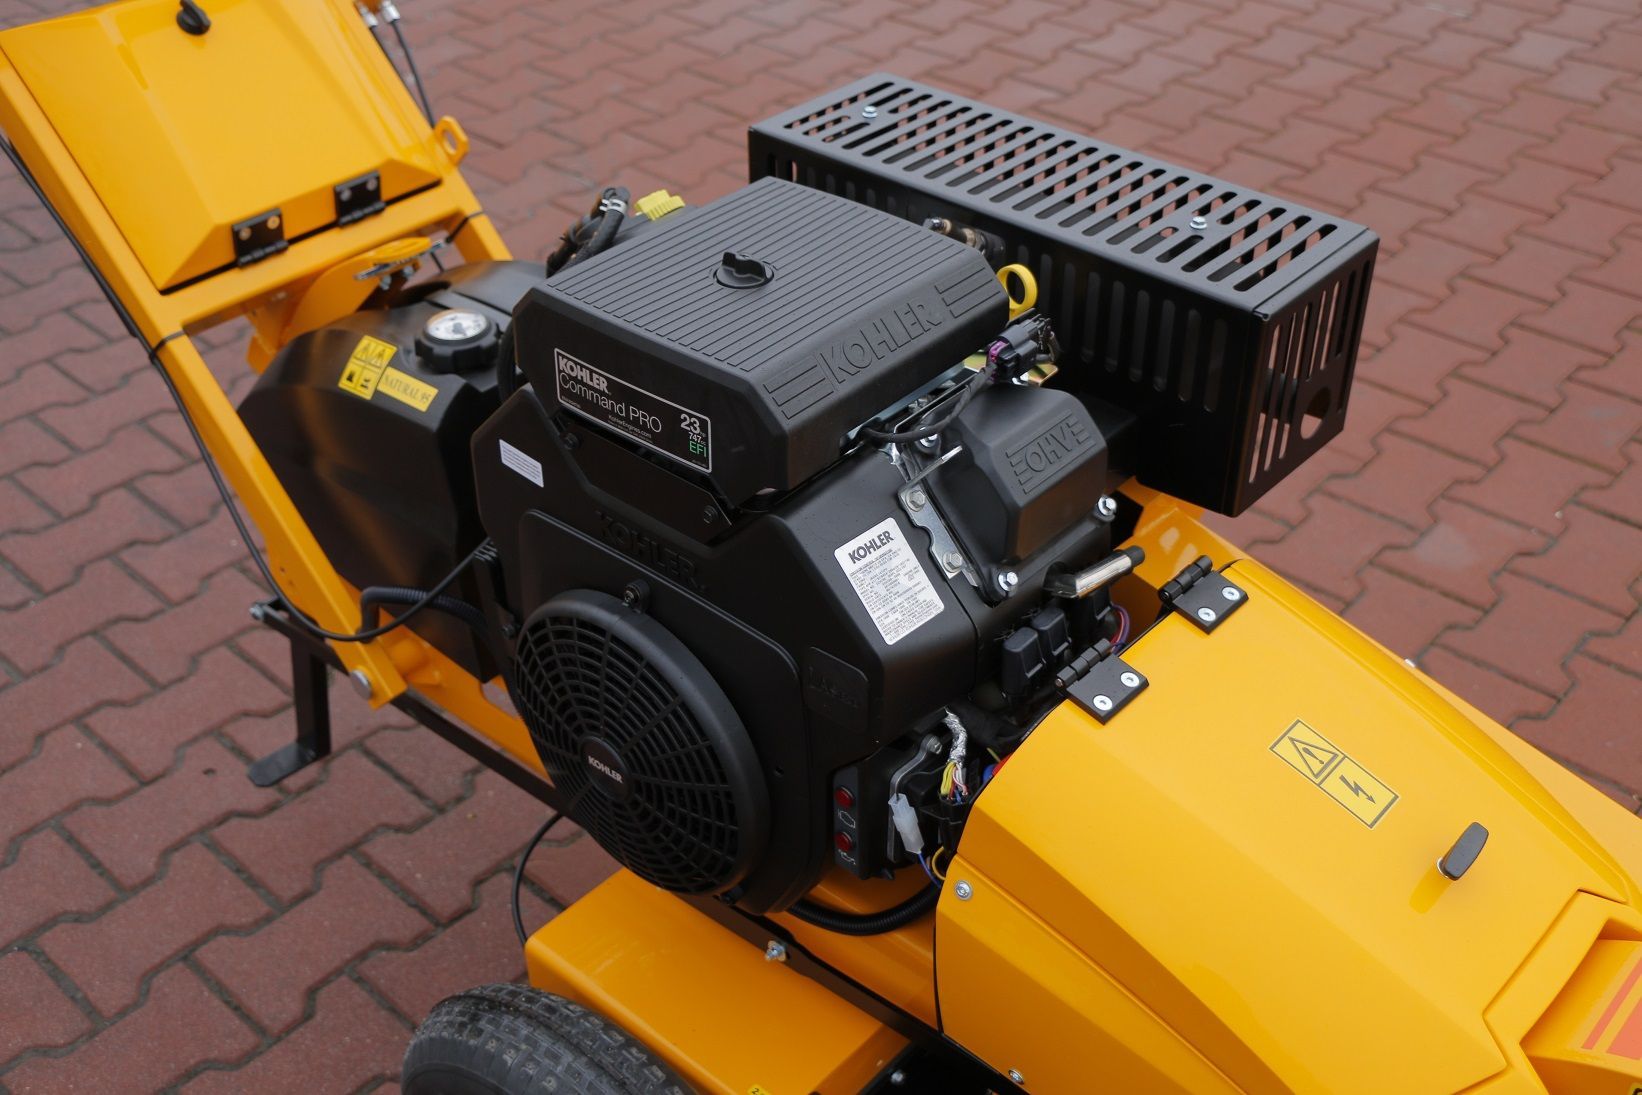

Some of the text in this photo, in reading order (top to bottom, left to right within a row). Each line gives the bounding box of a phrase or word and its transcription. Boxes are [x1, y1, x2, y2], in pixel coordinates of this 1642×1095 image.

[820, 301, 942, 384] KOHLER
[558, 355, 609, 394] KOHLER
[559, 372, 626, 417] Command
[629, 405, 662, 433] PRO
[680, 413, 700, 434] 23
[689, 432, 702, 443] 747
[689, 440, 707, 458] EFI
[848, 530, 894, 564] KOHLER
[588, 755, 623, 784] KOHLER
